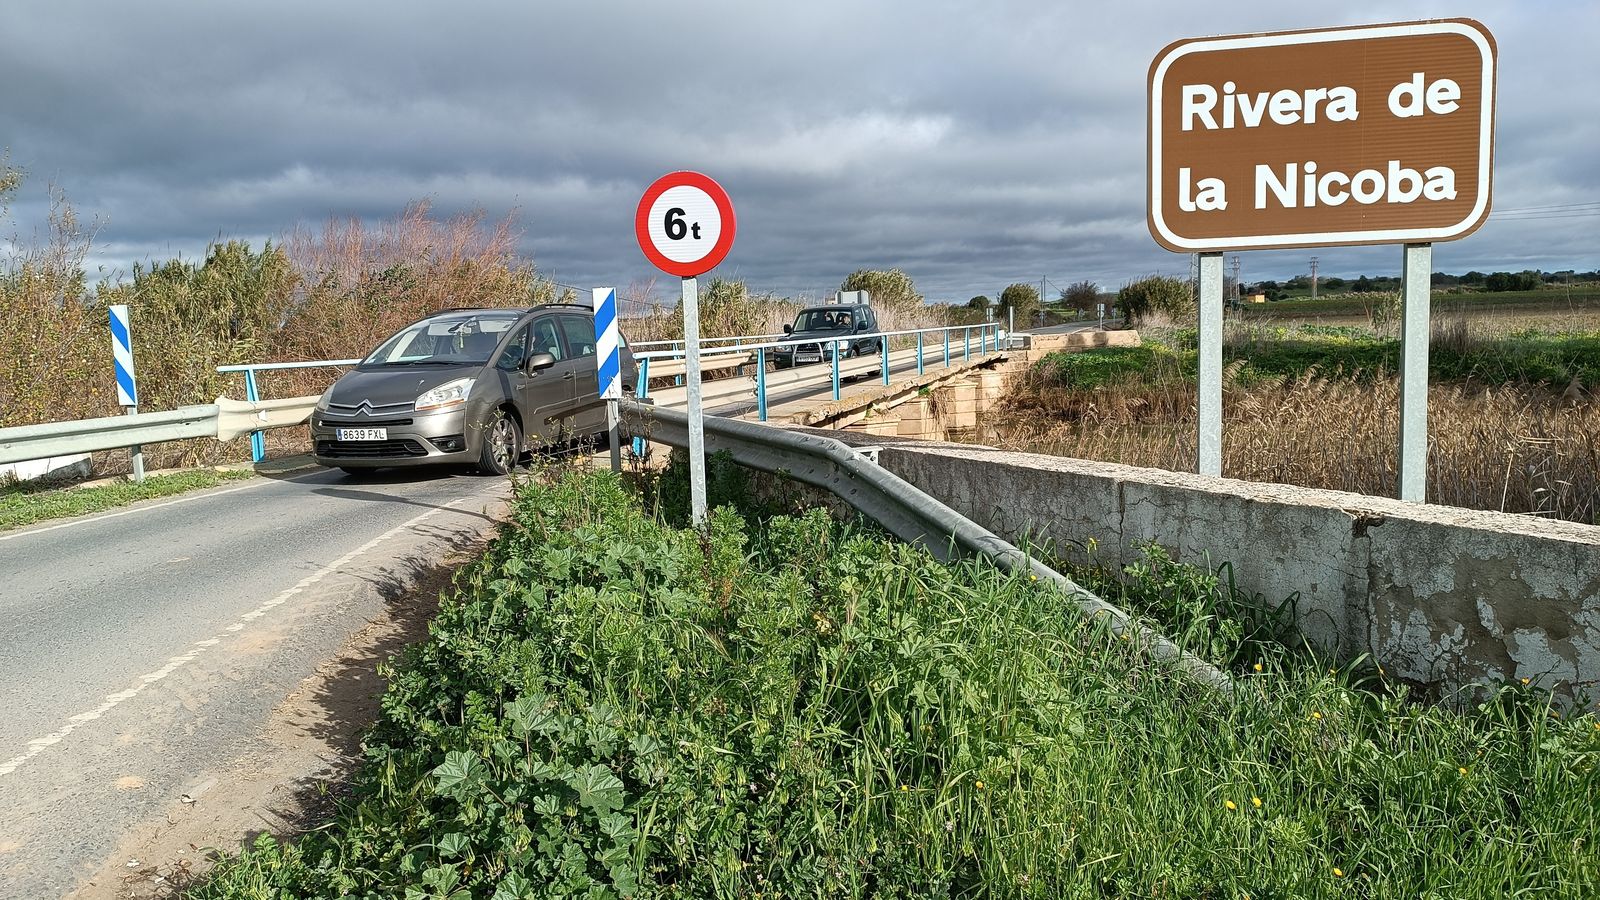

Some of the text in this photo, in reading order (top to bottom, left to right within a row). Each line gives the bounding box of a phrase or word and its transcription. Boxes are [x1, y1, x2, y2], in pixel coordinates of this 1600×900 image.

[1182, 72, 1461, 131] Rivera de
[1179, 160, 1458, 212] la Nicoba
[343, 429, 385, 439] 8639 FXL
